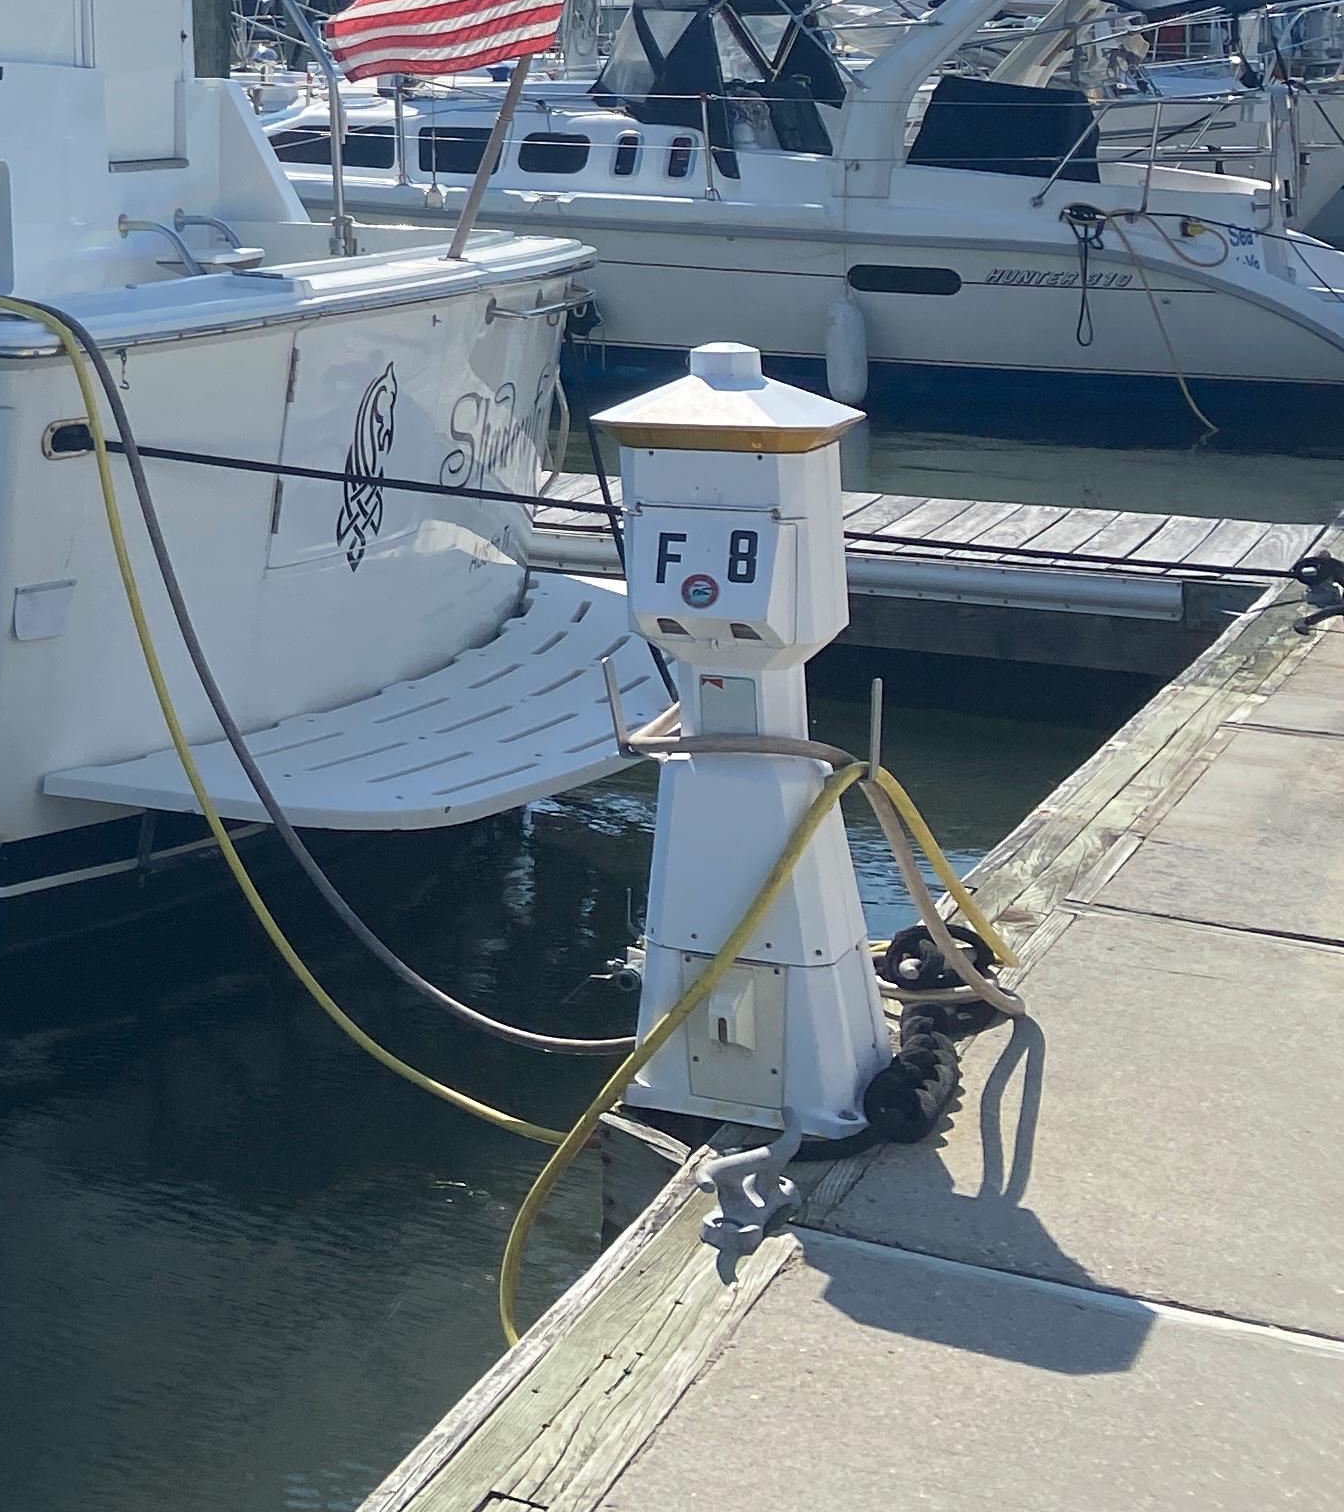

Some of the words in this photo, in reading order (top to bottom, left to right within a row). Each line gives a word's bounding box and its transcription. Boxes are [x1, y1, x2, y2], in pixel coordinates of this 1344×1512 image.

[984, 267, 1078, 287] HUNTER
[655, 531, 688, 585] F
[726, 529, 759, 585] 8
